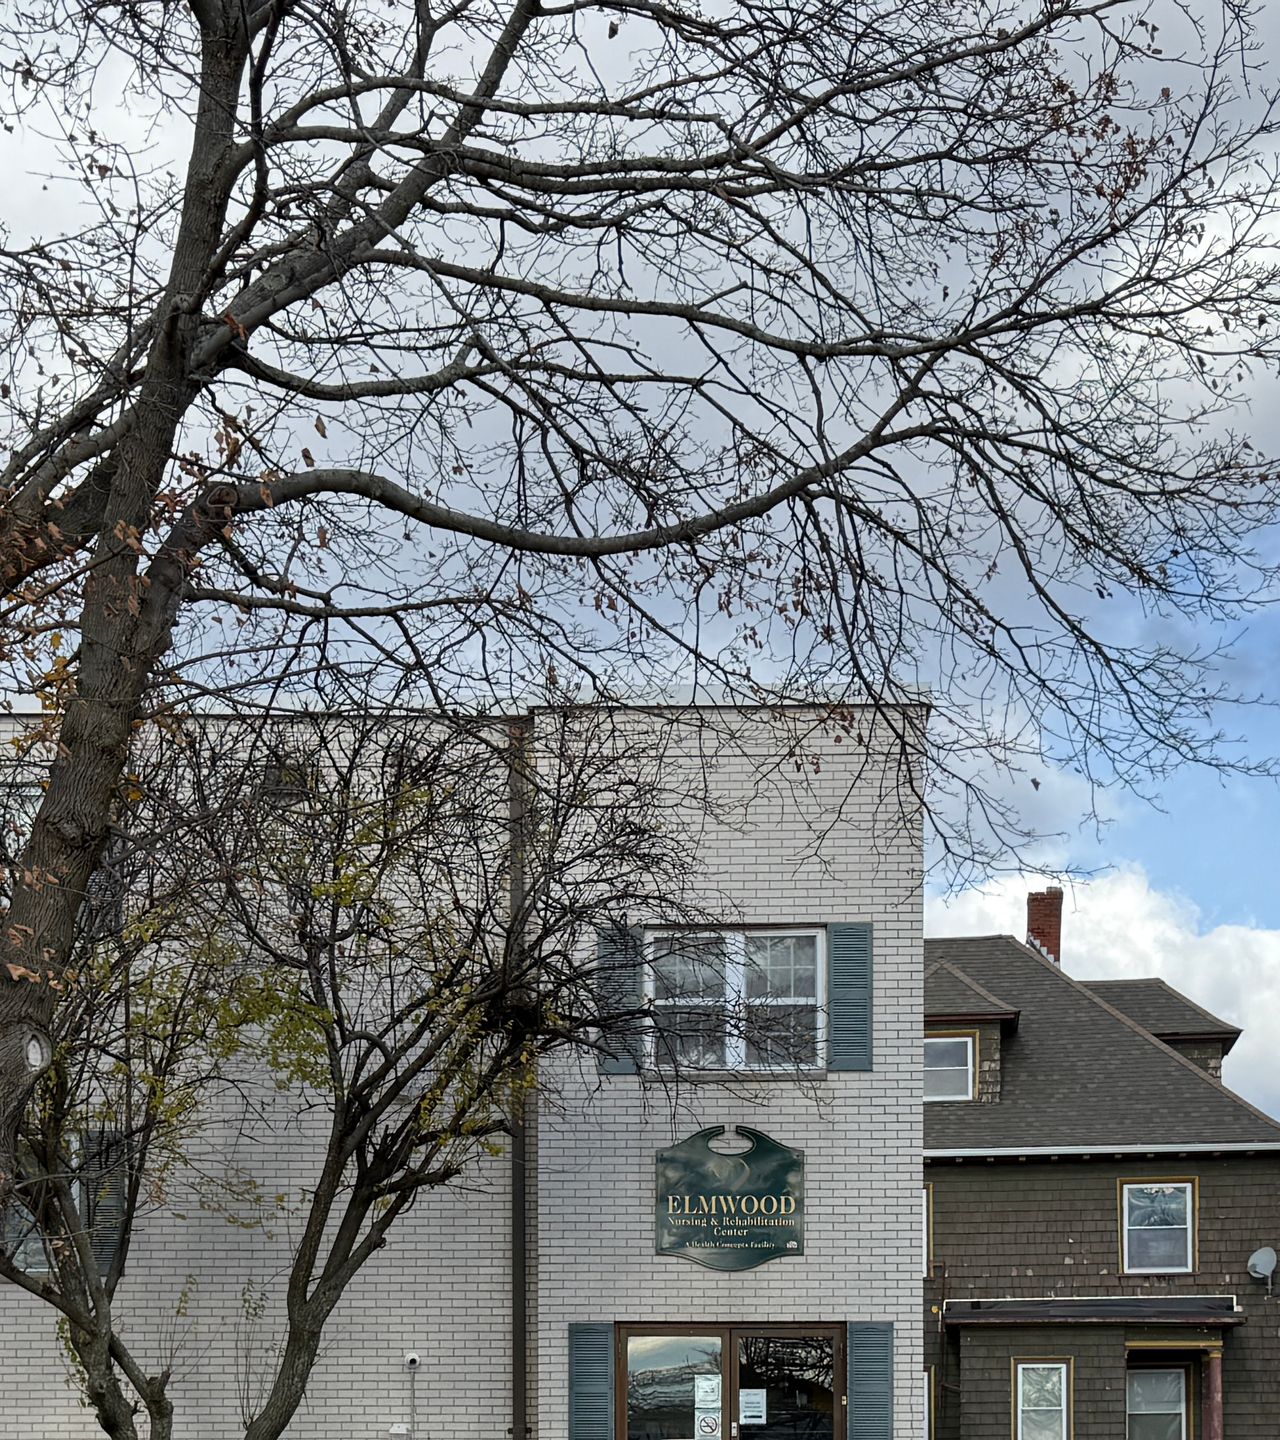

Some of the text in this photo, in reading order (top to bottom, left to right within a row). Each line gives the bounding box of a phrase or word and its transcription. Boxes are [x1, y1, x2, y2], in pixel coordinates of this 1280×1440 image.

[667, 1195, 796, 1215] ELMWOOD
[668, 1216, 795, 1228] Nursing & Rehabilitation
[714, 1227, 749, 1236] Center
